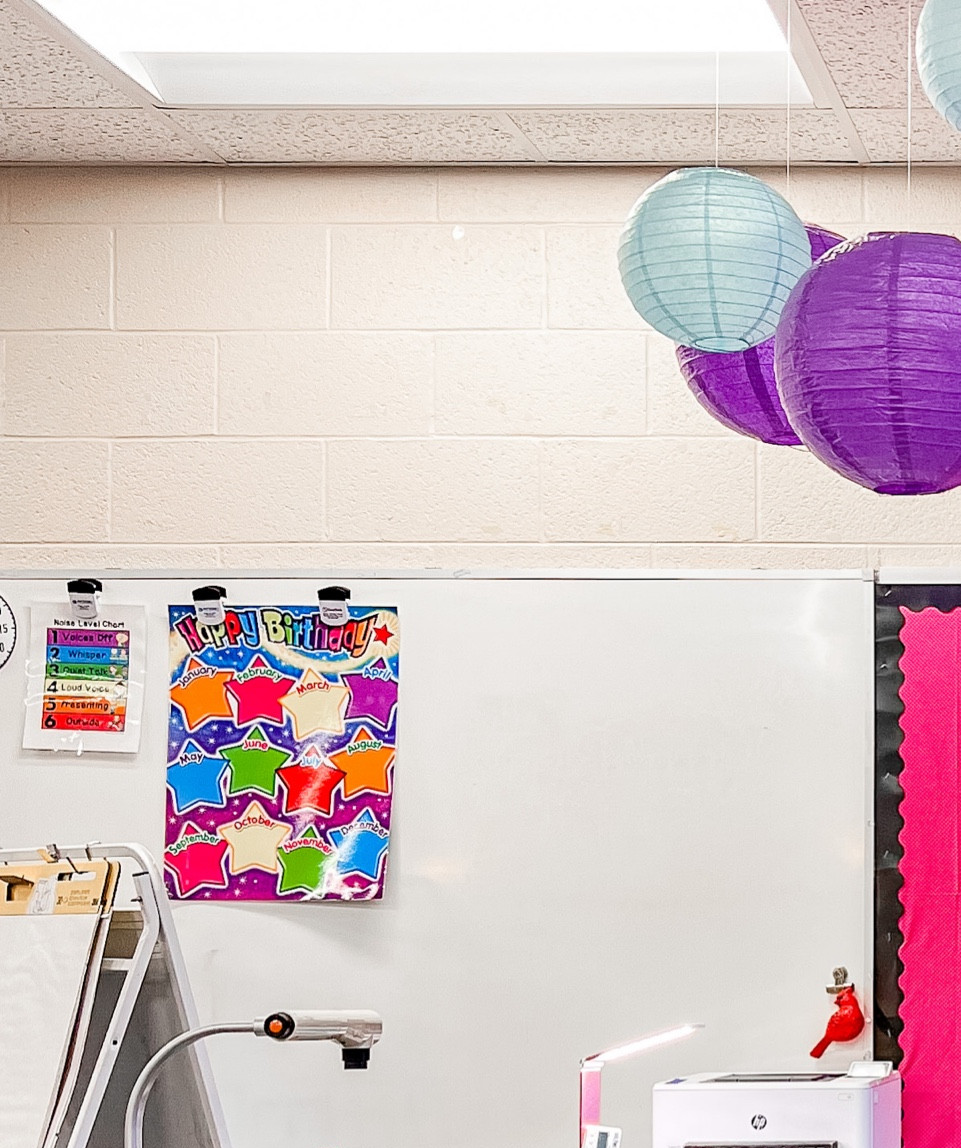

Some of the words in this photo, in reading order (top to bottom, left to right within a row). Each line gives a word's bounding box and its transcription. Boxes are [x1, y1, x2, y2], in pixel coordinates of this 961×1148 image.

[78, 619, 100, 628] Level
[51, 629, 58, 644] 1
[97, 632, 113, 643] Off
[175, 609, 260, 651] Happy
[262, 608, 378, 658] Birthday
[49, 647, 60, 660] 2
[68, 650, 107, 660] Whisper
[48, 663, 60, 678] 3
[178, 665, 217, 687] January
[236, 663, 283, 682] February
[363, 667, 393, 680] April
[46, 681, 59, 693] 4
[61, 684, 82, 692] Loud
[296, 680, 330, 695] March
[45, 698, 56, 711] 5
[44, 714, 57, 729] 6
[242, 739, 270, 751] June
[346, 740, 384, 754] August
[179, 752, 205, 765] May
[301, 757, 324, 767] July
[234, 816, 277, 830] October
[341, 822, 388, 838] Deember
[168, 833, 222, 855] September
[283, 838, 334, 854] November
[751, 1114, 767, 1130] hp
